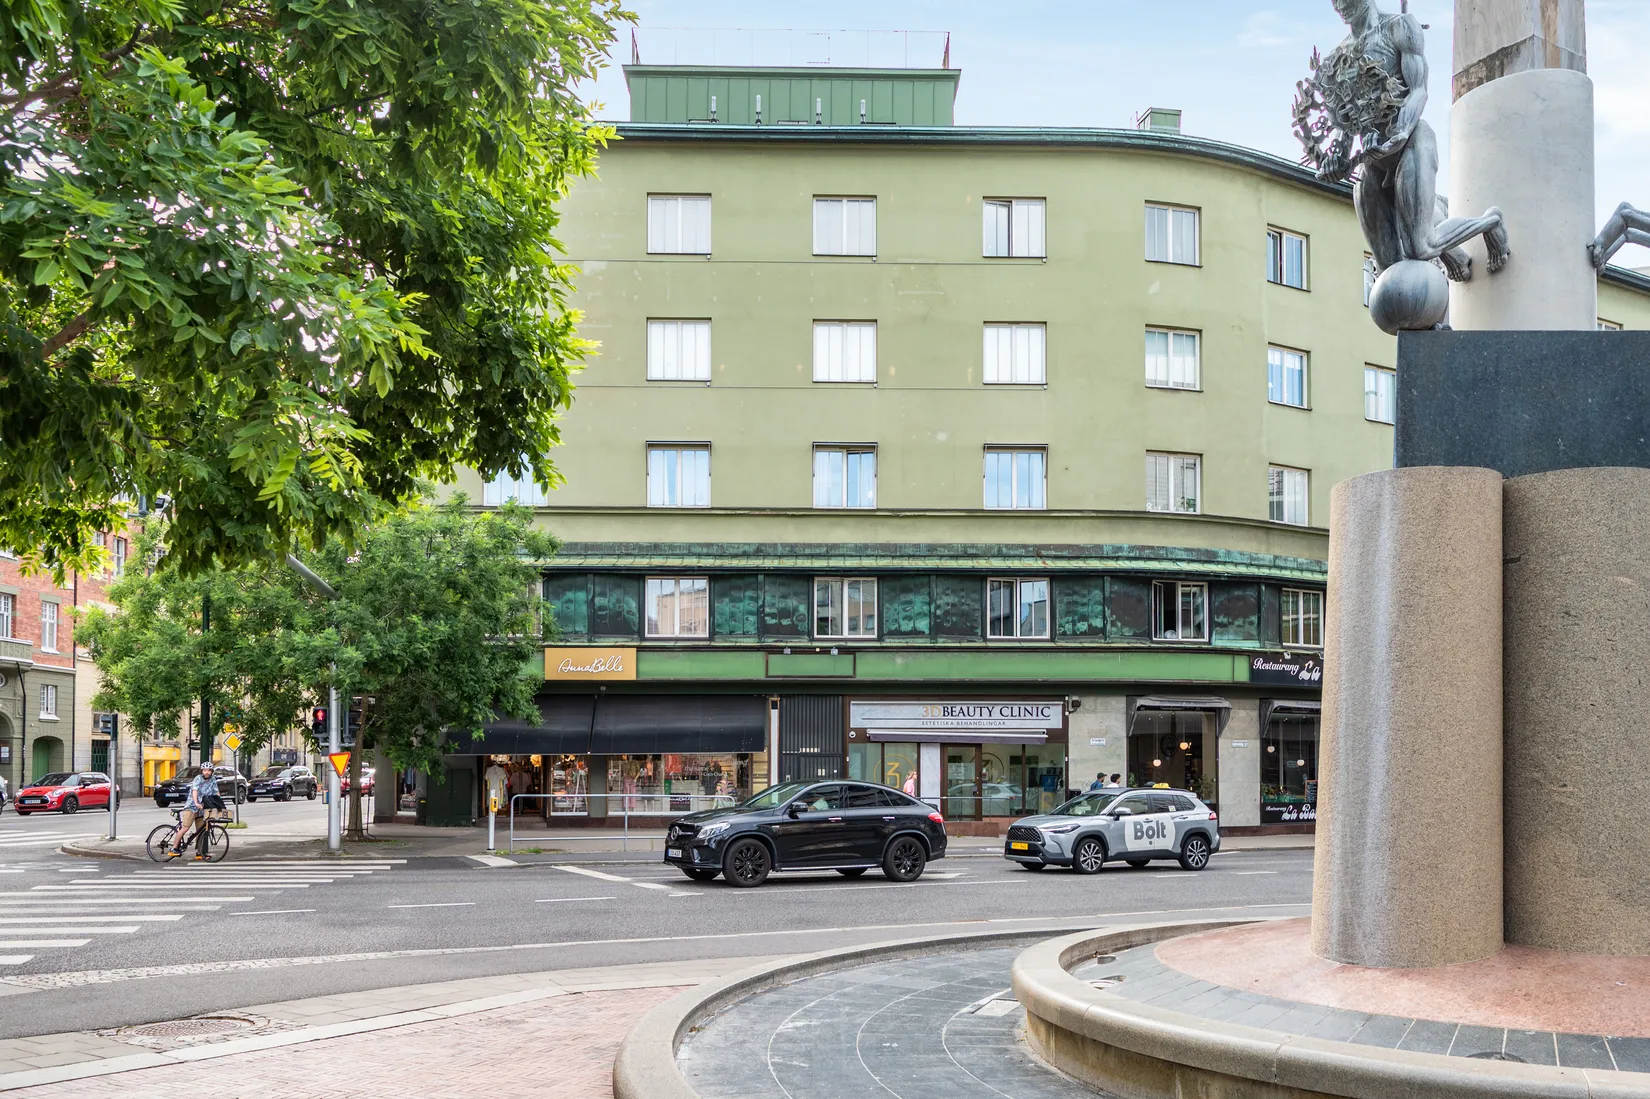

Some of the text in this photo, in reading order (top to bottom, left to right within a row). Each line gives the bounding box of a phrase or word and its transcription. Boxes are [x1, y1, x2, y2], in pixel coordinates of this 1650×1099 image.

[557, 655, 624, 673] AnnaBelle
[1252, 657, 1321, 681] Restaurang La
[999, 706, 1051, 718] CLINIC
[1133, 820, 1167, 840] Bolt
